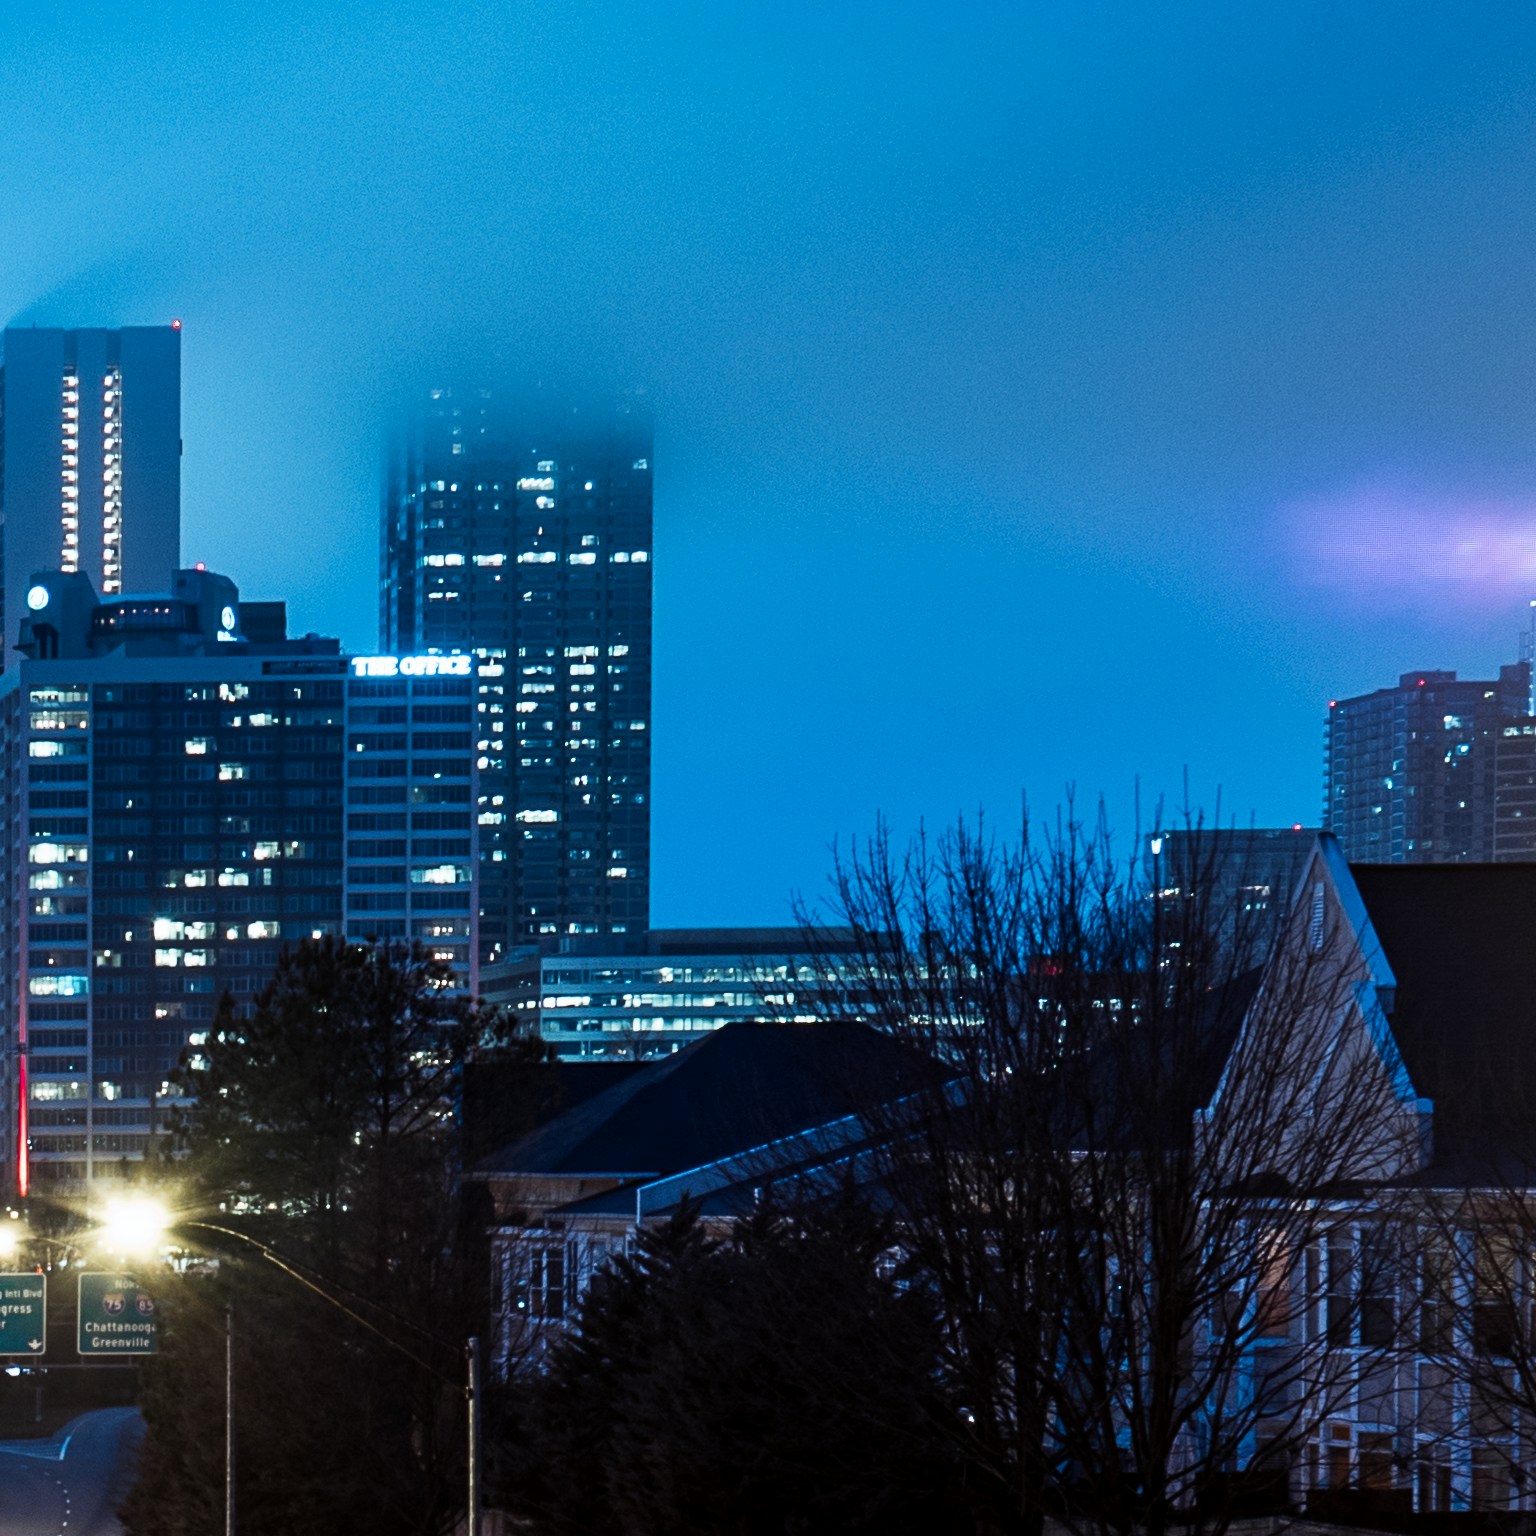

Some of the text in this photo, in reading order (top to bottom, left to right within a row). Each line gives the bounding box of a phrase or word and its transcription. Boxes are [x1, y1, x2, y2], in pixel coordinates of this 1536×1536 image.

[351, 656, 399, 677] THE
[399, 655, 472, 677] OFFICE
[23, 1289, 43, 1298] Blvd
[107, 1299, 154, 1311] 75 85
[92, 1337, 150, 1348] Greenville
